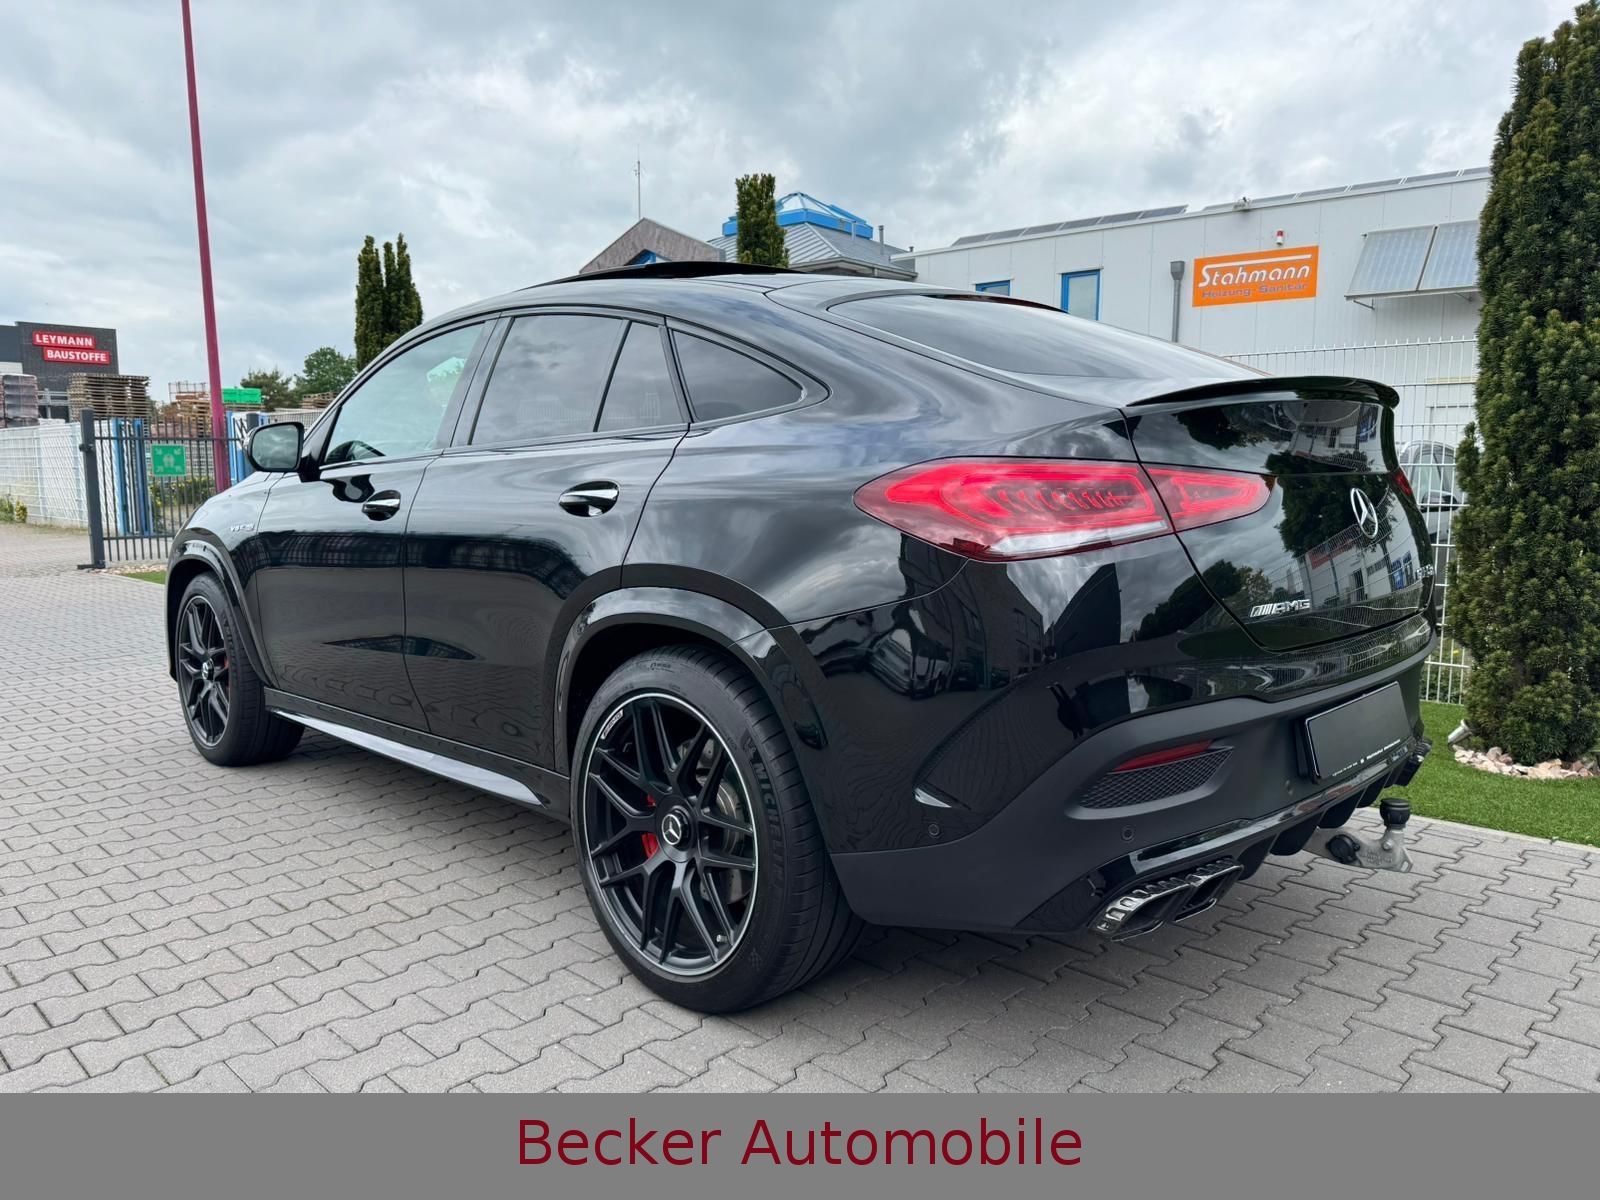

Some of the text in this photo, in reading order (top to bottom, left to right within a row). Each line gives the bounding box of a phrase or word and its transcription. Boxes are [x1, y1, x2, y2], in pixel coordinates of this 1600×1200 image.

[1198, 254, 1312, 288] Stahmann
[35, 334, 93, 346] LEYMANN
[46, 349, 107, 361] BAUSTOFFE
